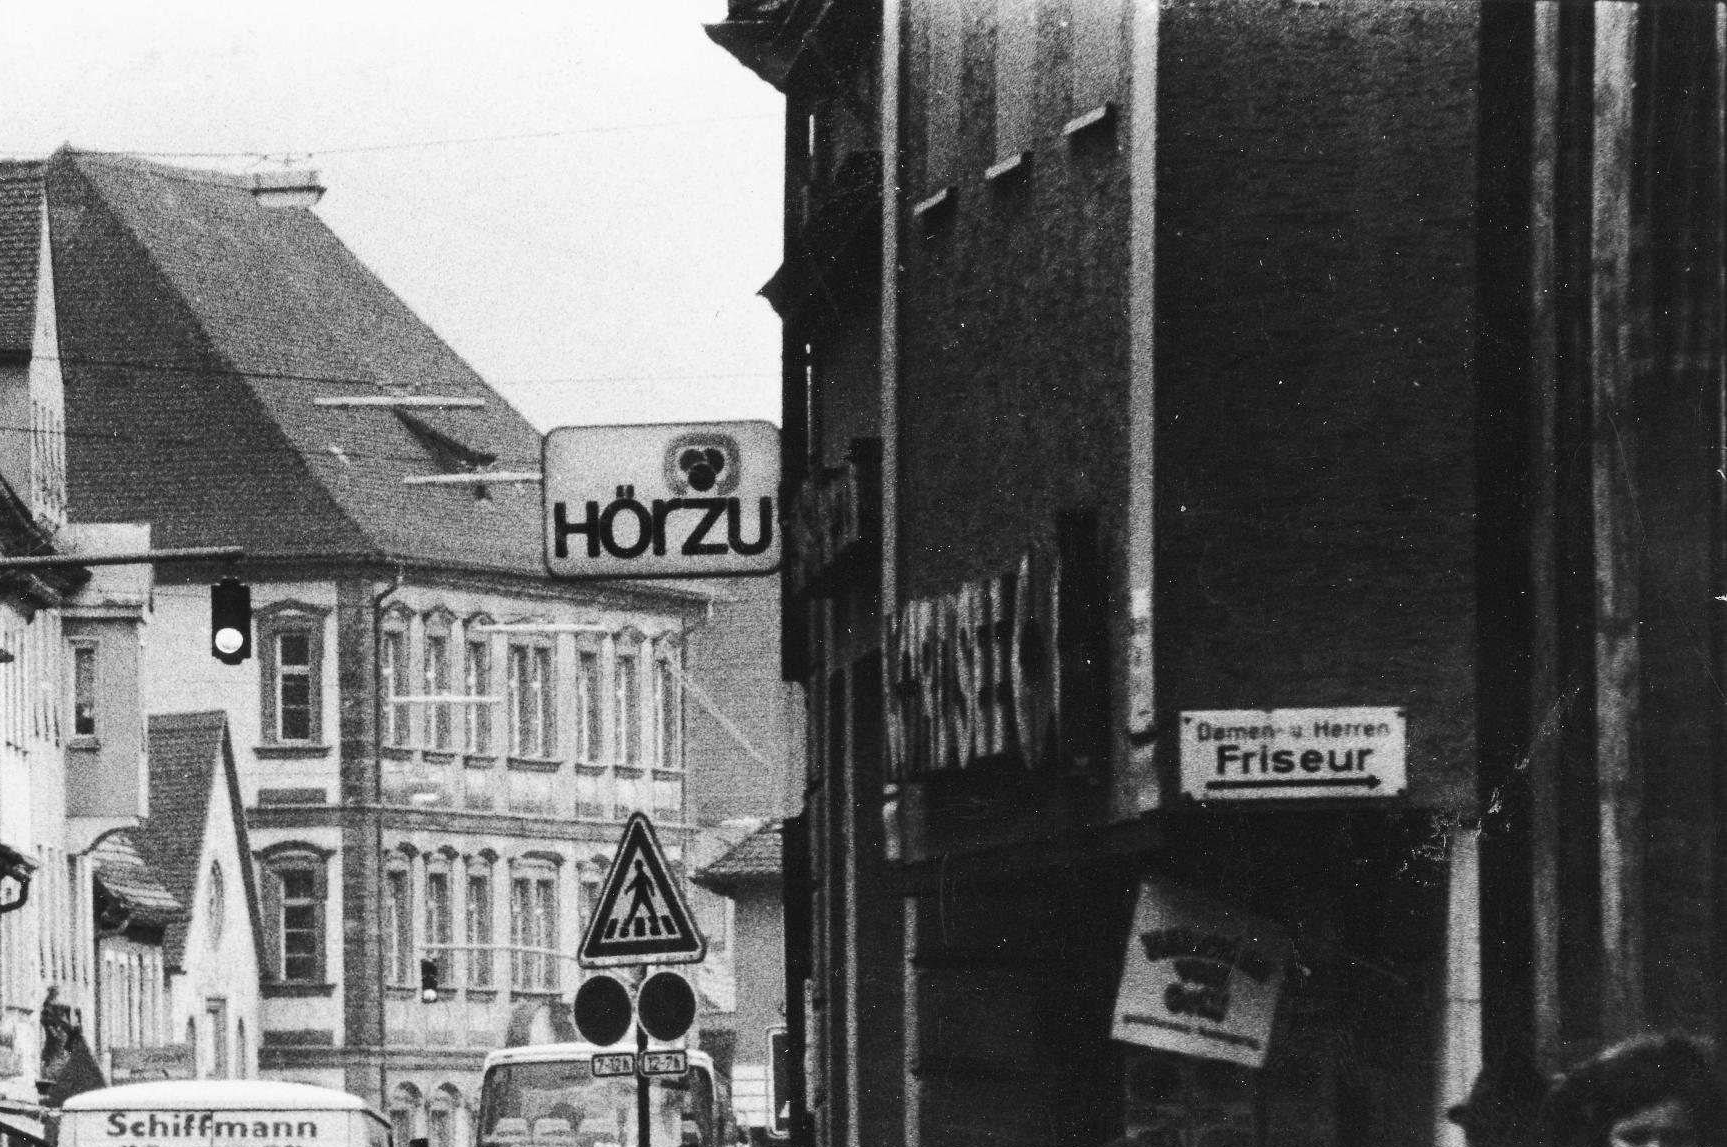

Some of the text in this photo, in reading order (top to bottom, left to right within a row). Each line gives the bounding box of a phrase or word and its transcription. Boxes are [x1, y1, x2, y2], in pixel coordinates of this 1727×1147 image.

[1314, 720, 1390, 738] Herren
[1217, 745, 1373, 774] Friseur
[107, 1112, 317, 1137] Schiffmann
